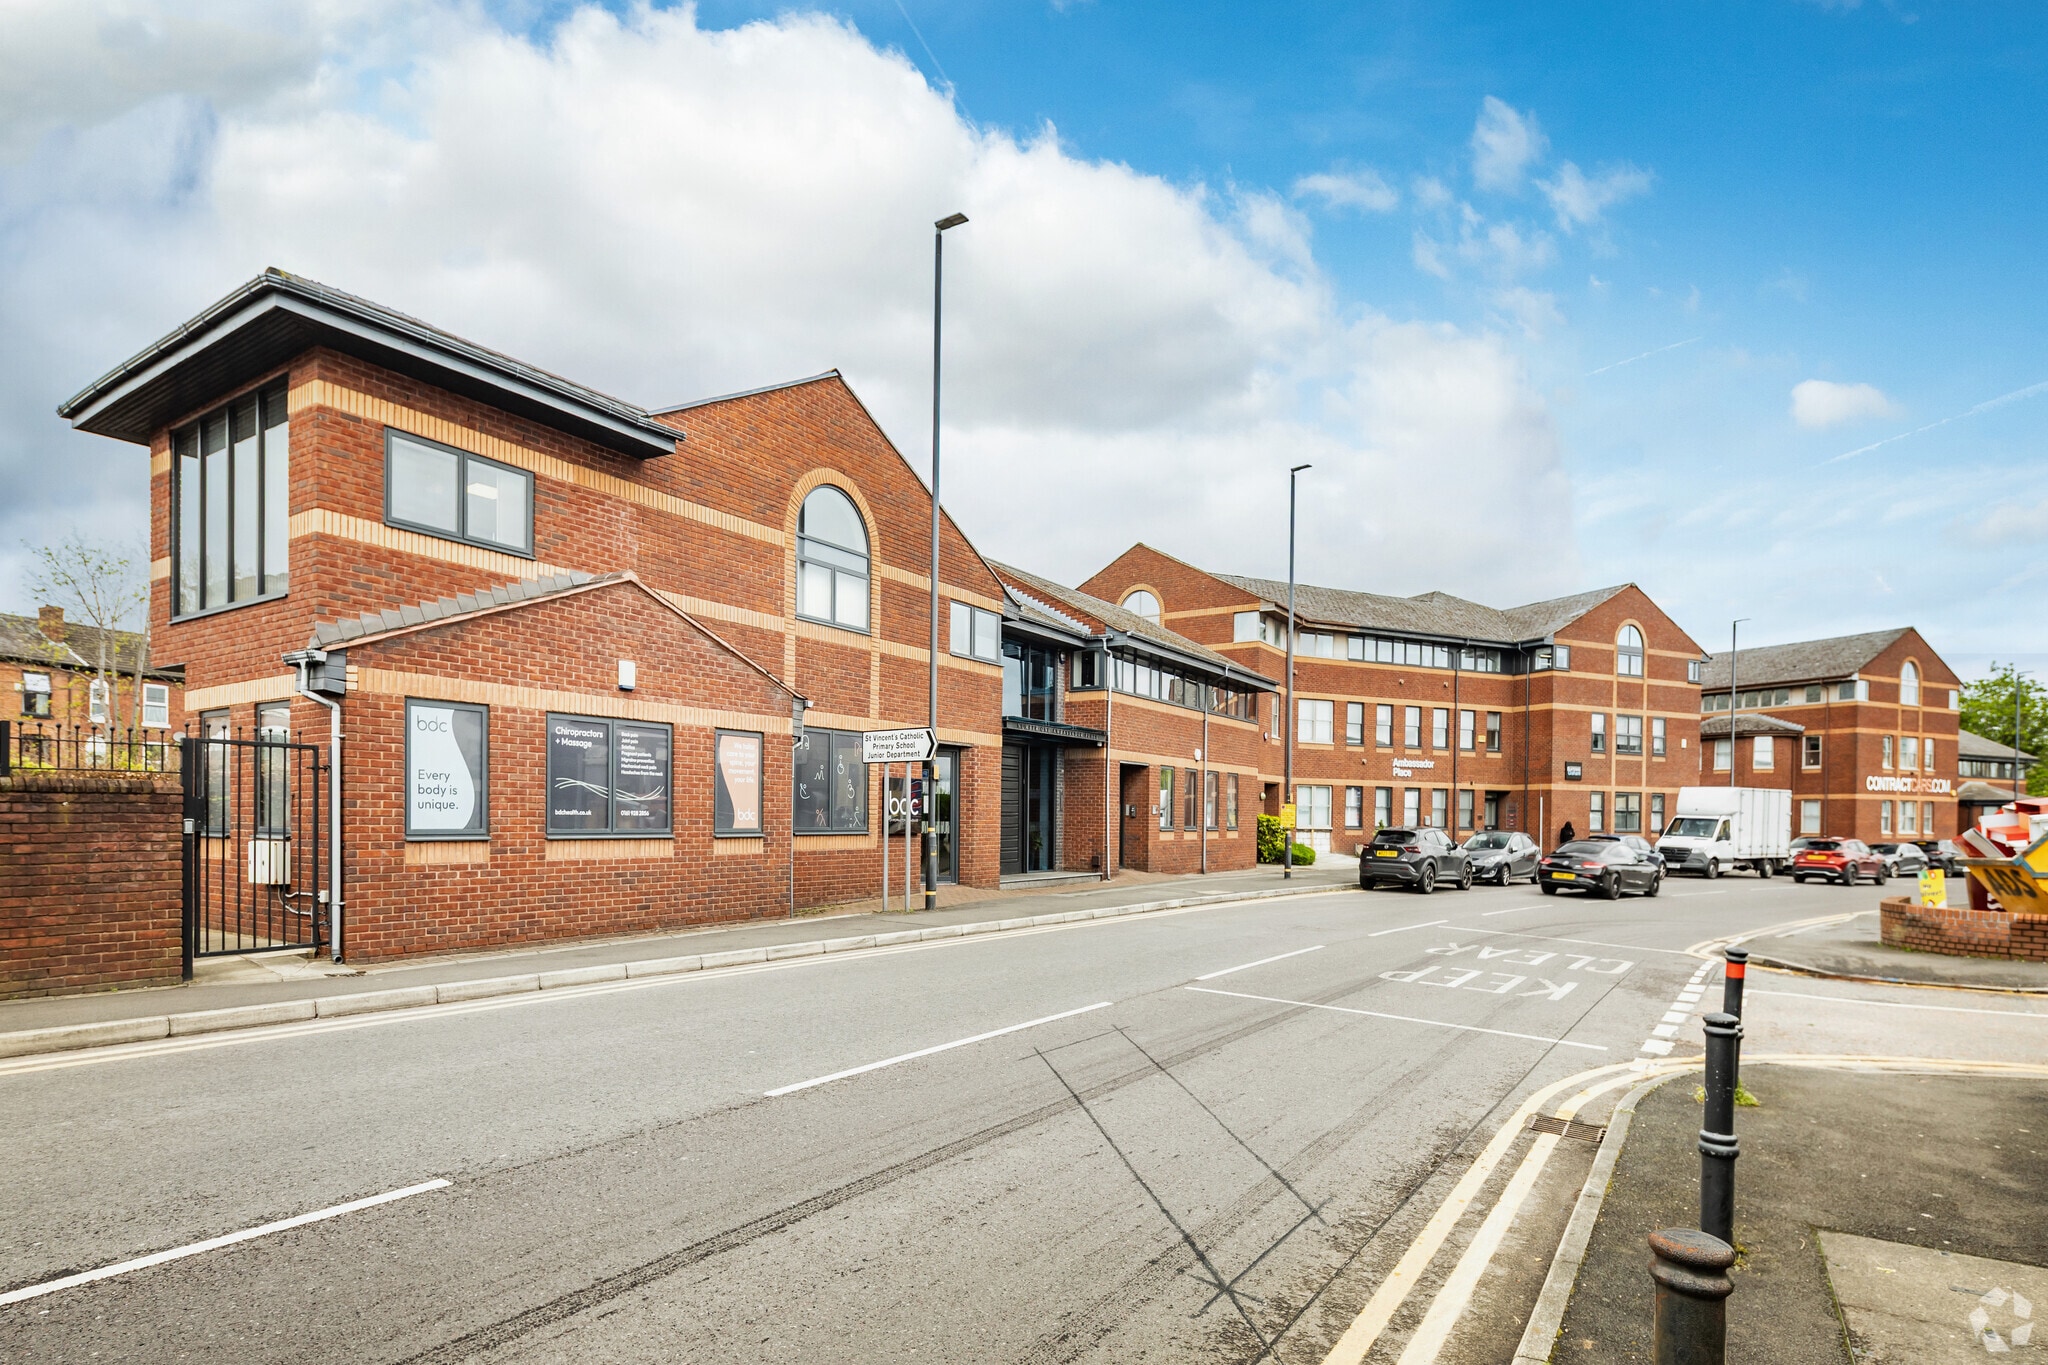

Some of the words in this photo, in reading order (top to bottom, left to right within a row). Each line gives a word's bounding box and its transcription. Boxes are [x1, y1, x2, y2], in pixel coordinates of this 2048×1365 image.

[416, 715, 448, 732] bdc
[555, 726, 604, 738] Chiropractors
[873, 733, 898, 741] Vincent's
[900, 732, 924, 740] Catholic
[561, 737, 593, 749] Massage
[873, 743, 894, 751] Primary
[886, 750, 921, 759] Department
[1392, 757, 1435, 769] Ambassador
[418, 769, 450, 783] Every
[1392, 767, 1412, 777] Place
[417, 784, 447, 797] body
[449, 785, 458, 795] is
[1866, 776, 1951, 793] CONTRACTCARS.COM
[418, 799, 459, 811] unique.
[737, 808, 756, 820] bdc
[1983, 868, 2039, 899] ADS
[1425, 942, 1635, 974] CLEAR
[1378, 965, 1579, 1000] KEEP
